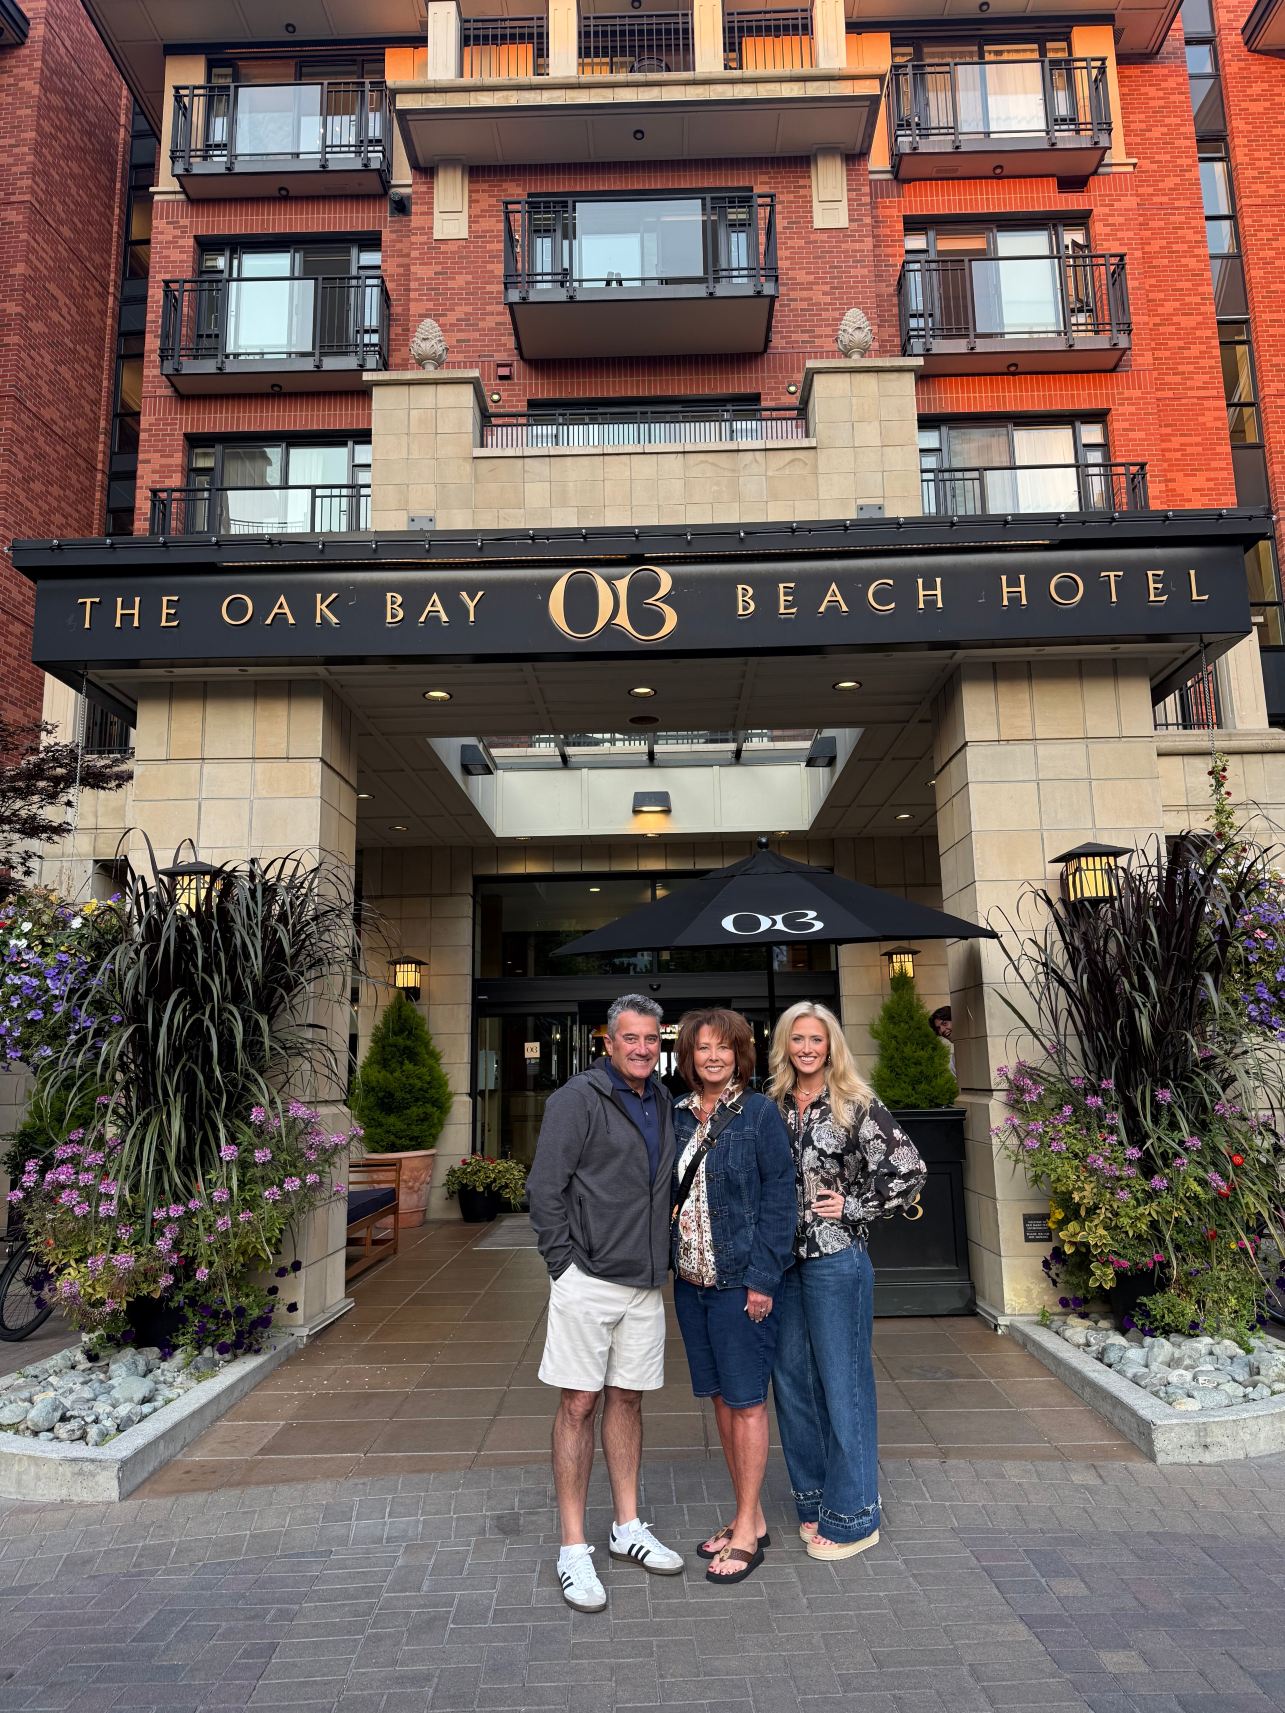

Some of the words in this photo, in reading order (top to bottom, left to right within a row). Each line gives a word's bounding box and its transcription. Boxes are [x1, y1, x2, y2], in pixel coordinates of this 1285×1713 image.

[77, 595, 180, 629] THE
[221, 592, 342, 626] OAK
[385, 591, 486, 625] BAY
[547, 566, 678, 641] OB
[736, 576, 944, 617] BEACH
[1000, 568, 1210, 609] HOTEL
[721, 909, 825, 936] OB
